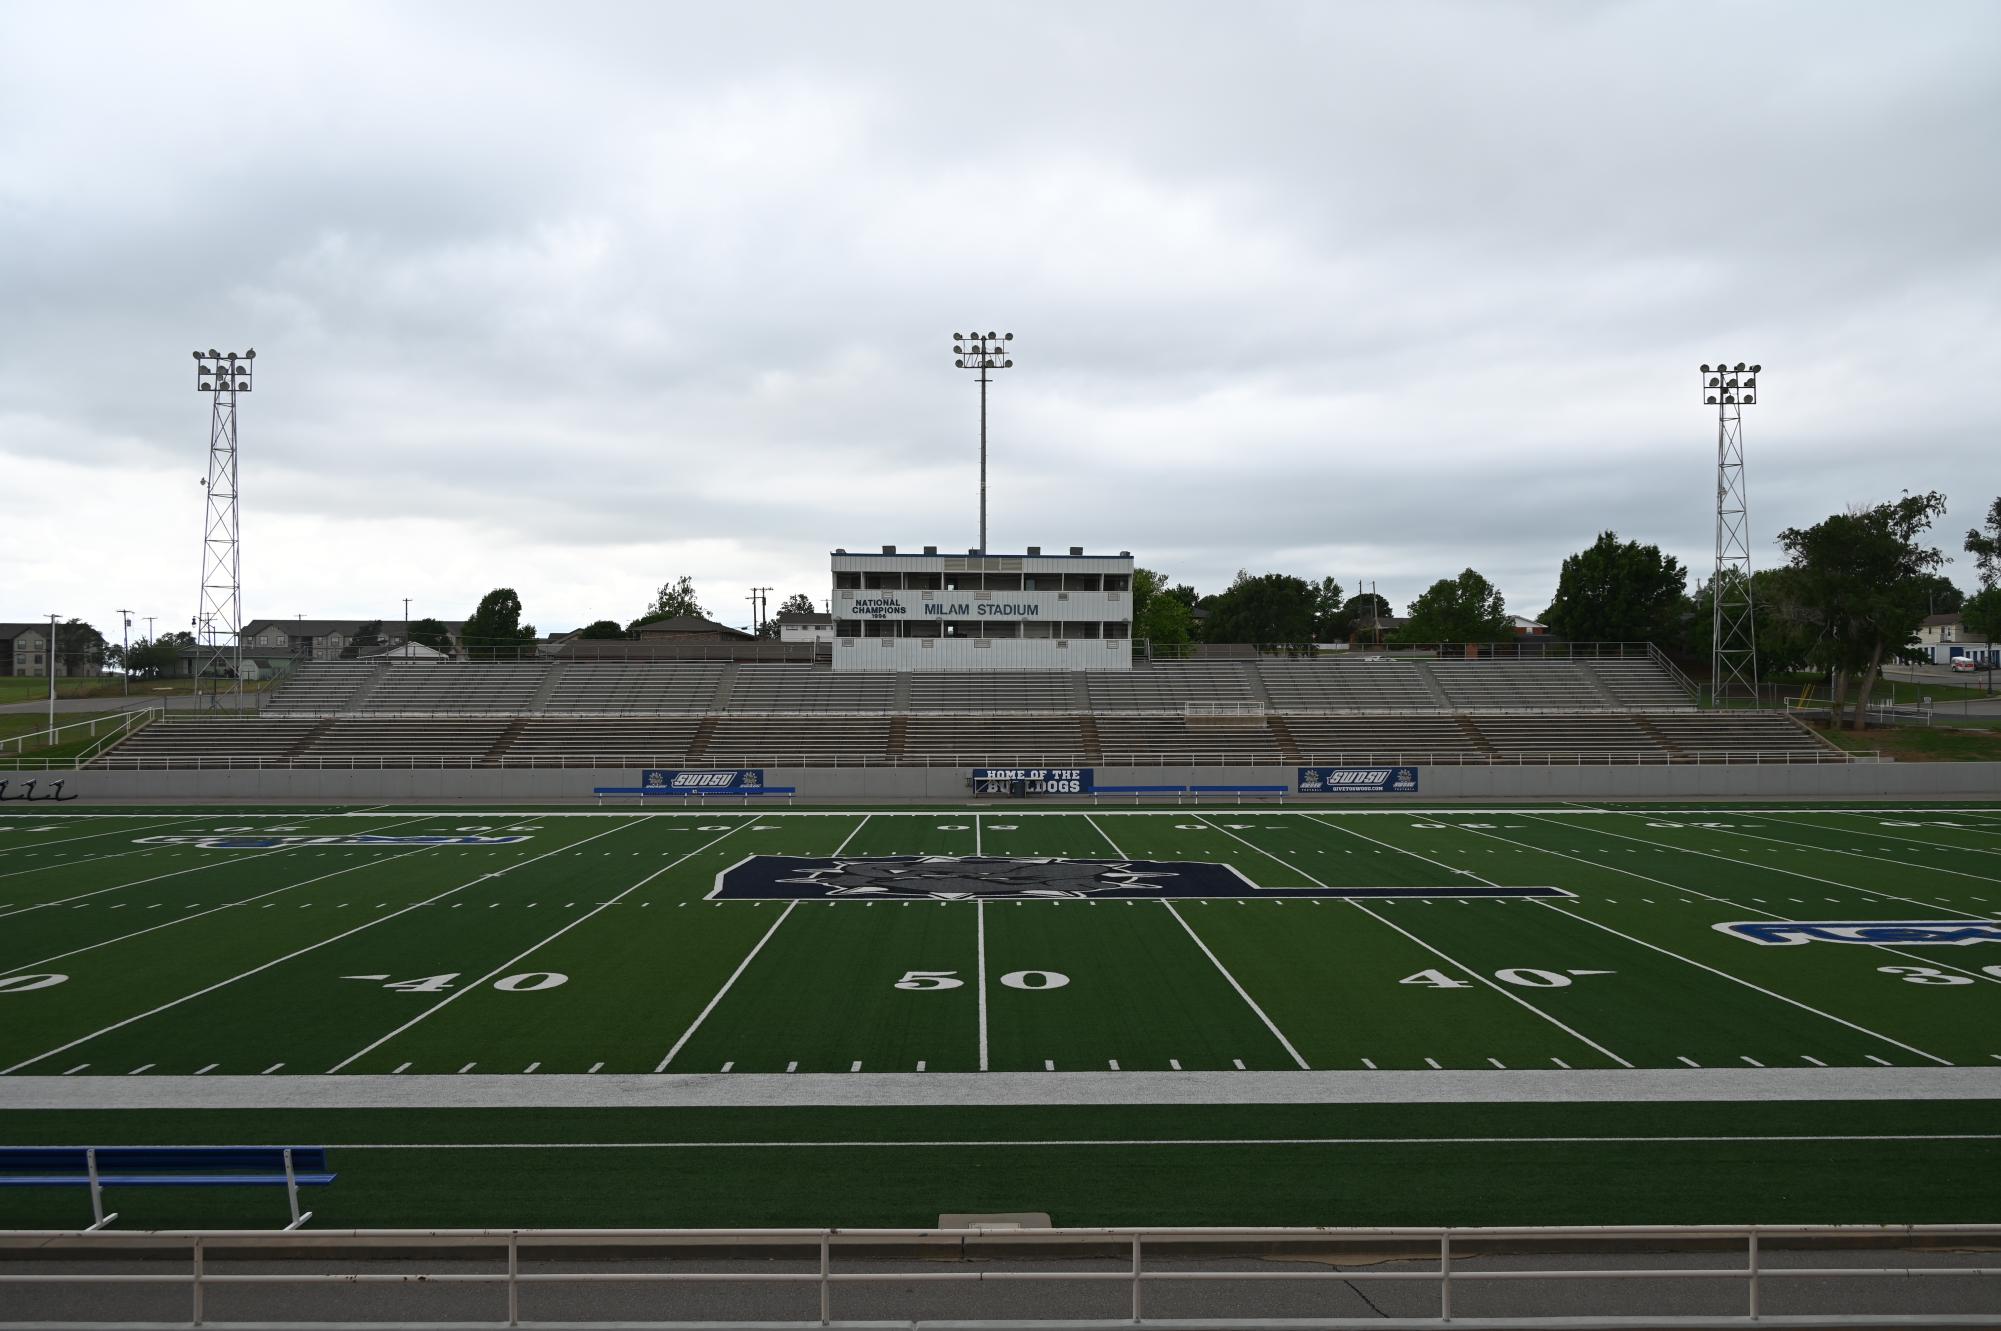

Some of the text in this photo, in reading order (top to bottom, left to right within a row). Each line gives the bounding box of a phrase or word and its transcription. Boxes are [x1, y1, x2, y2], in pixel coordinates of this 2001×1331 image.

[852, 606, 907, 614] CHAMPIONS
[924, 603, 1039, 616] MILAM STADIUM
[673, 773, 734, 786] SWOSU
[986, 770, 1080, 779] HOME OF THE
[1328, 770, 1388, 784] SWOSU
[986, 780, 1080, 793] BULDOGS
